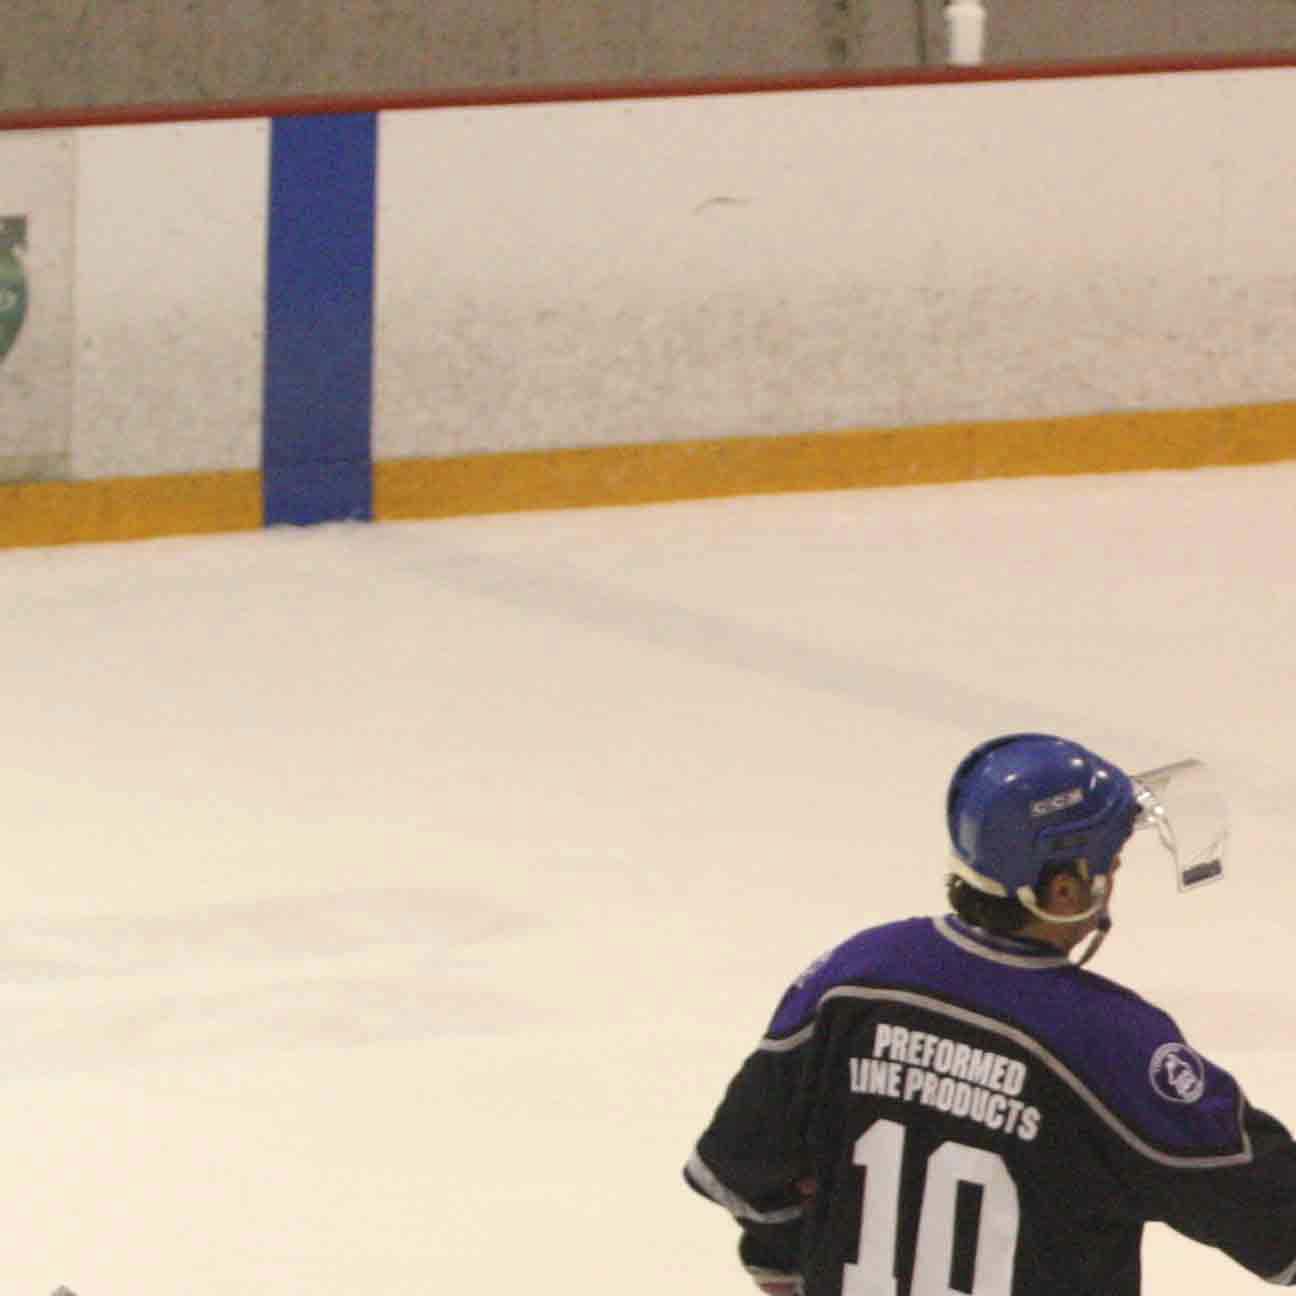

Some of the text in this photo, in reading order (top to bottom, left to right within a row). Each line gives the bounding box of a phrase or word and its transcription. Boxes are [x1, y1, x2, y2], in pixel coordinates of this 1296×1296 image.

[849, 1057, 1041, 1142] LINE PRODUCTS
[873, 1023, 1027, 1097] PREFORMED
